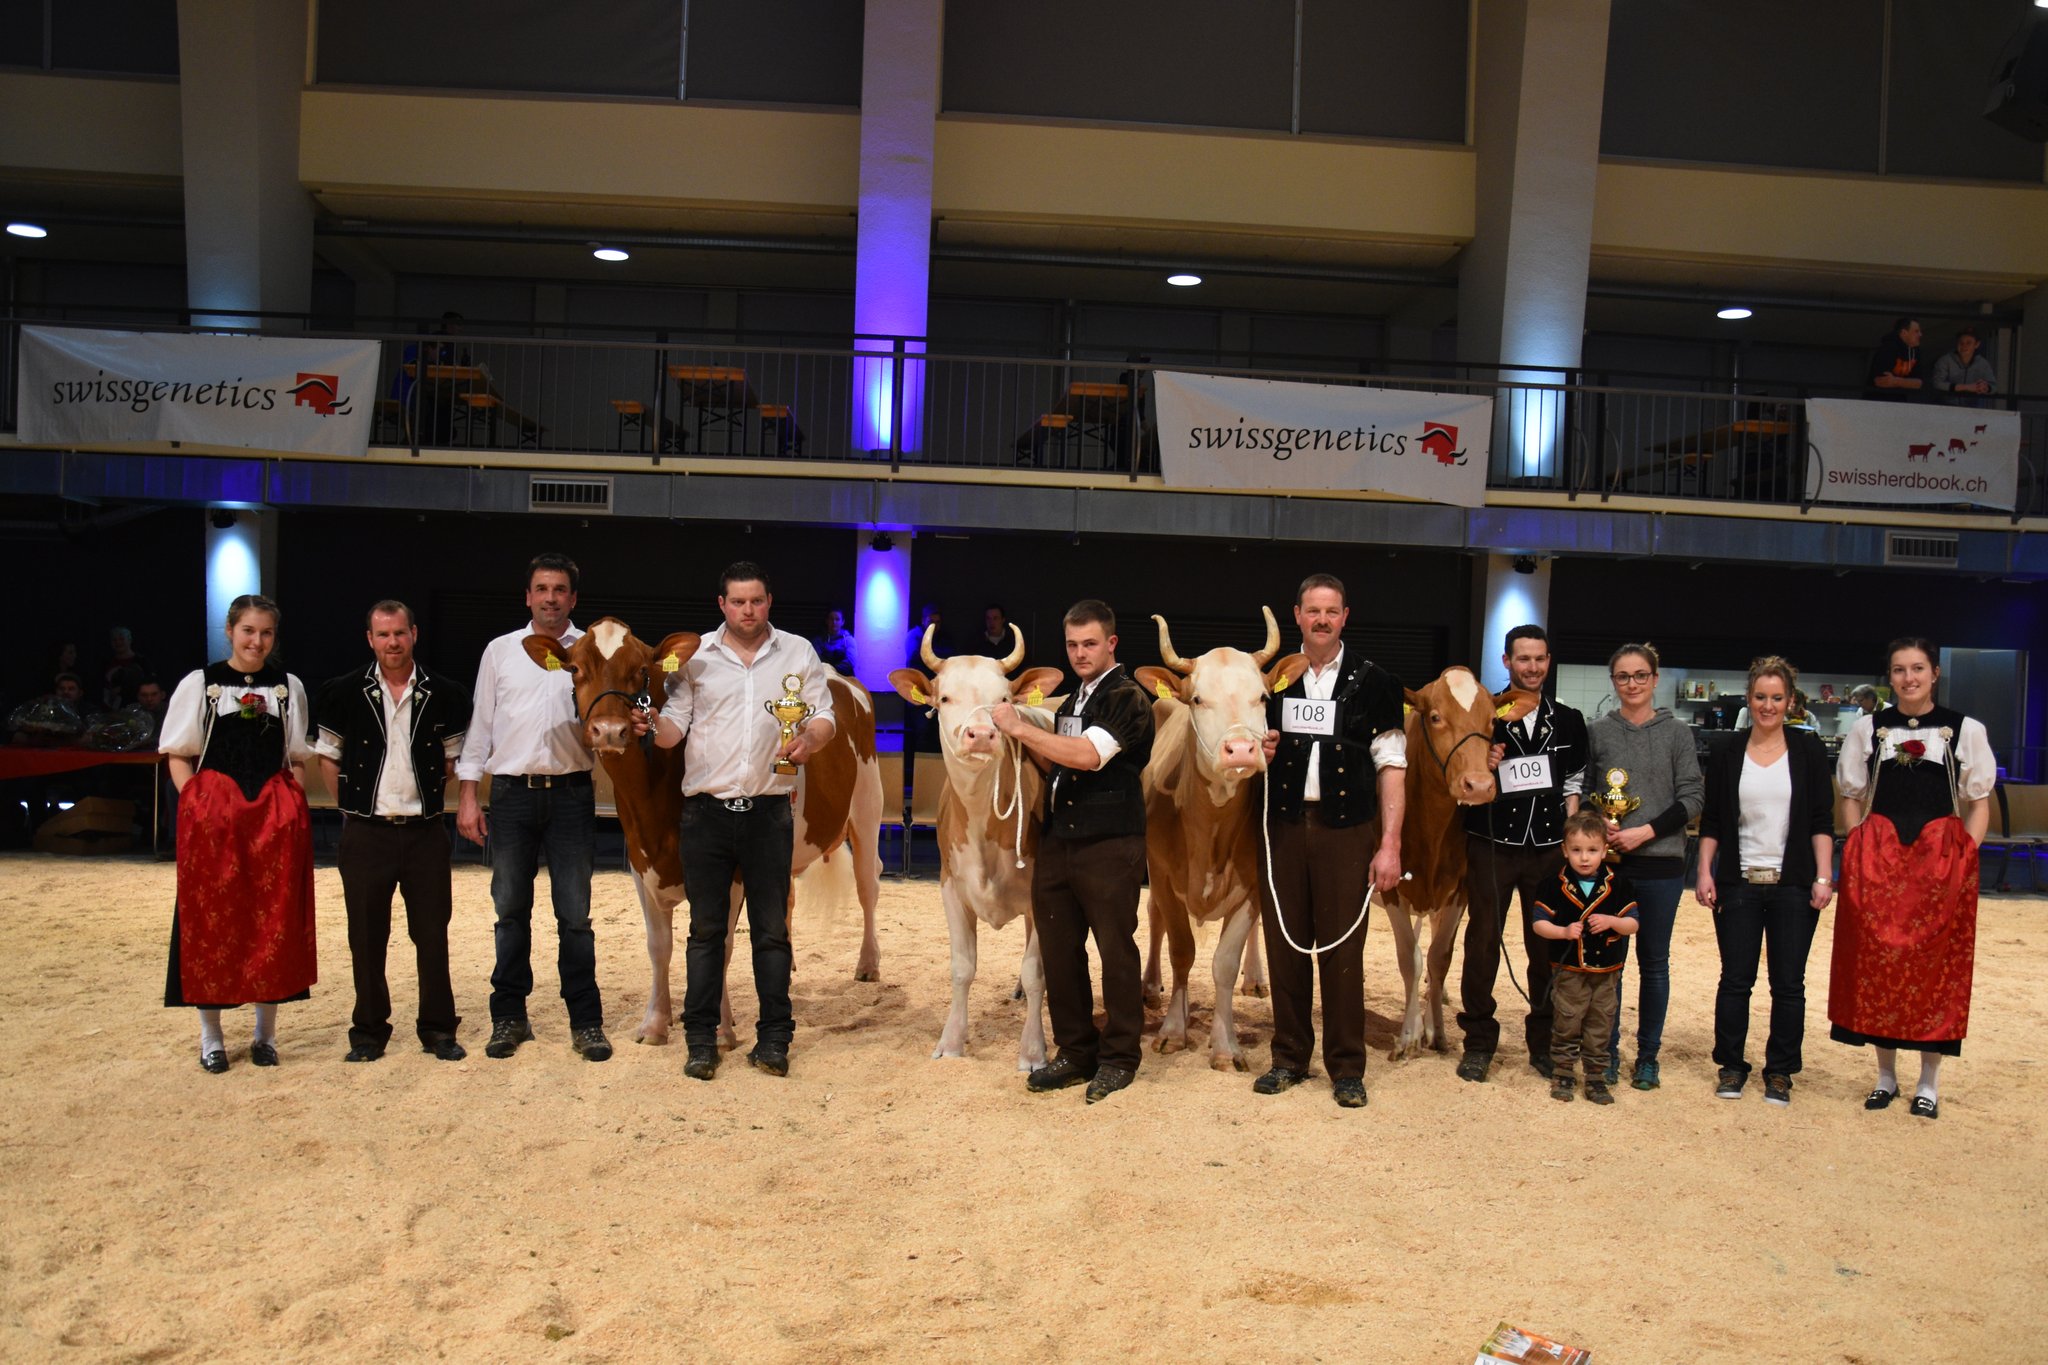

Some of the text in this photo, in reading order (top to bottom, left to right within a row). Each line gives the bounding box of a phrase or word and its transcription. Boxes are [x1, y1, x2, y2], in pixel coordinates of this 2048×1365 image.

[53, 370, 277, 413] swissgenetics
[1189, 416, 1408, 460] swissgenetics
[1828, 467, 1988, 493] swissherdbook.ch
[1292, 704, 1325, 722] 108
[1509, 761, 1542, 780] 109
